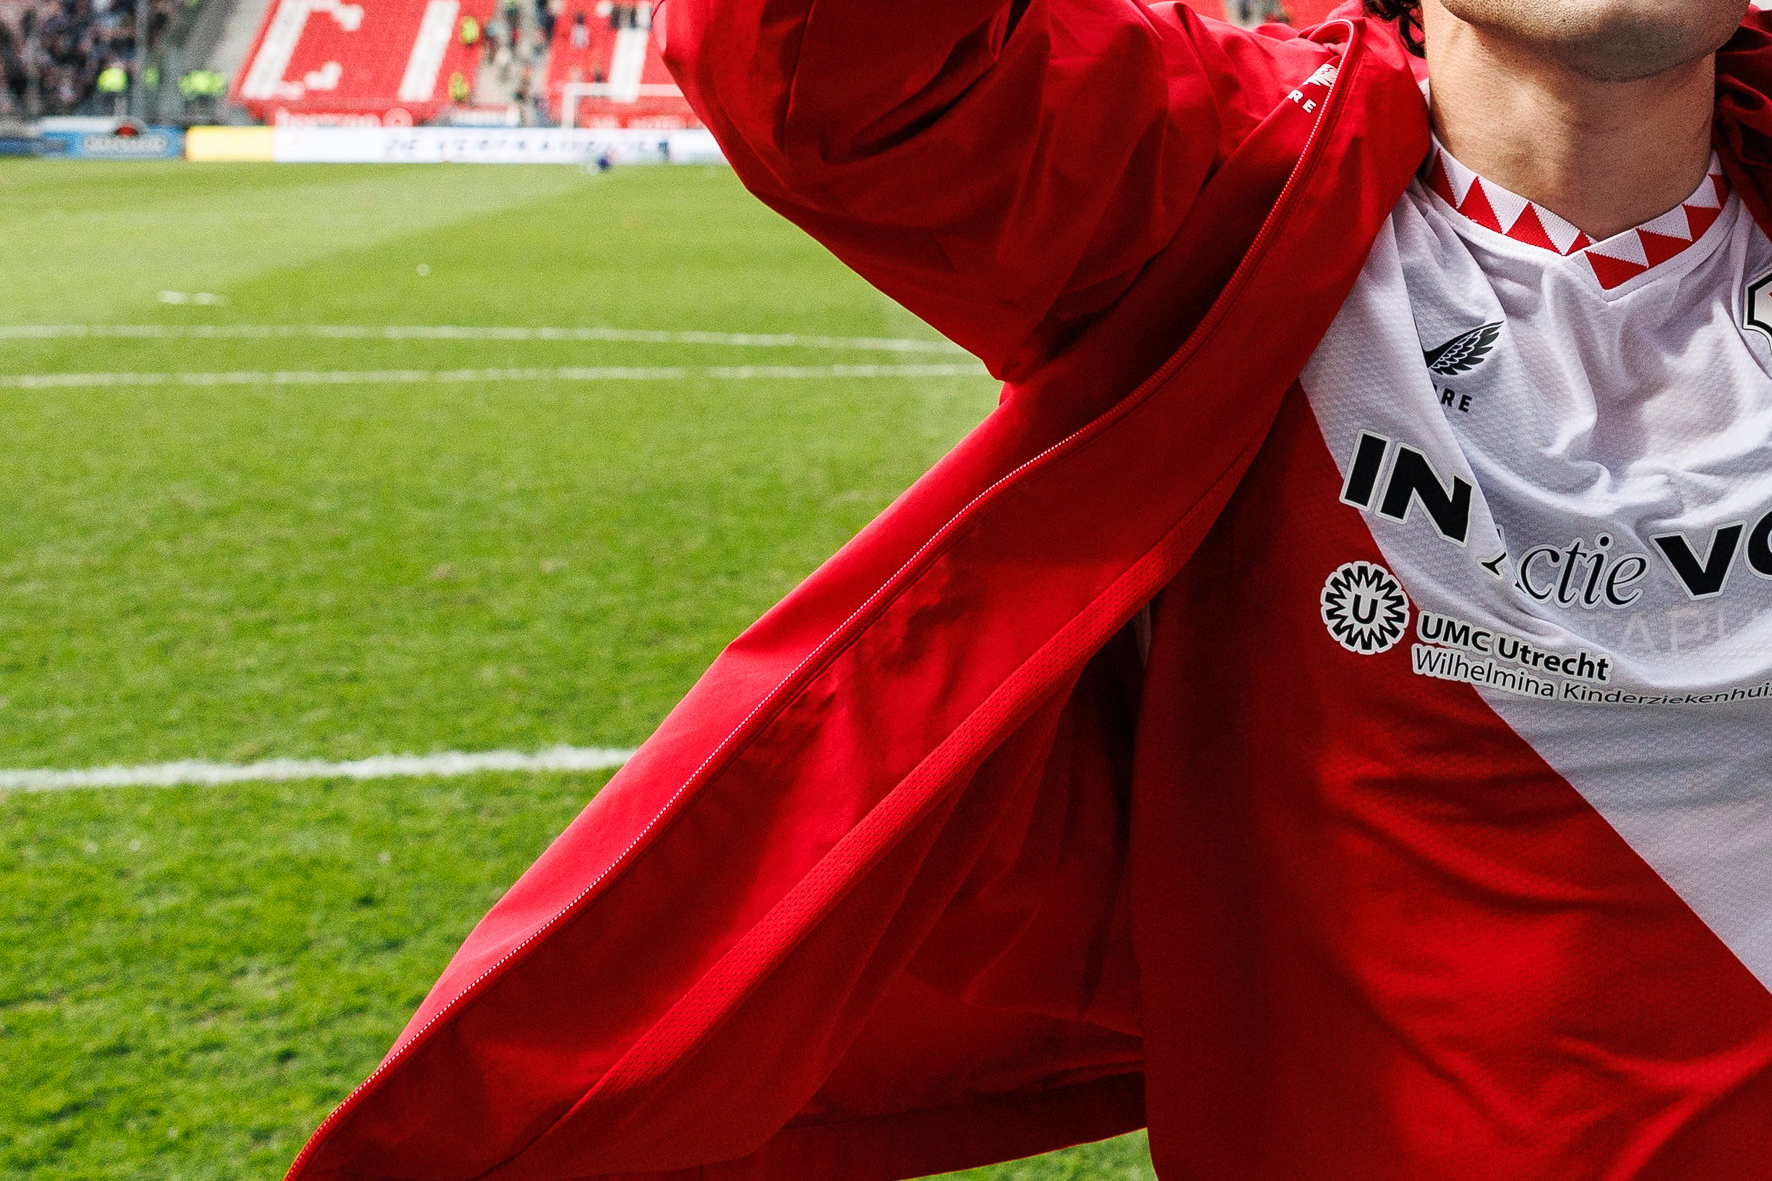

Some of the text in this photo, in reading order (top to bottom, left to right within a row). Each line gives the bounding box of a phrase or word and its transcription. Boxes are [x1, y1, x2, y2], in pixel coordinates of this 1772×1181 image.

[1343, 431, 1474, 545] IN
[1481, 526, 1647, 607] ctie
[1414, 646, 1555, 698] Wilhelmina
[1421, 614, 1610, 682] UMC Utrecht
